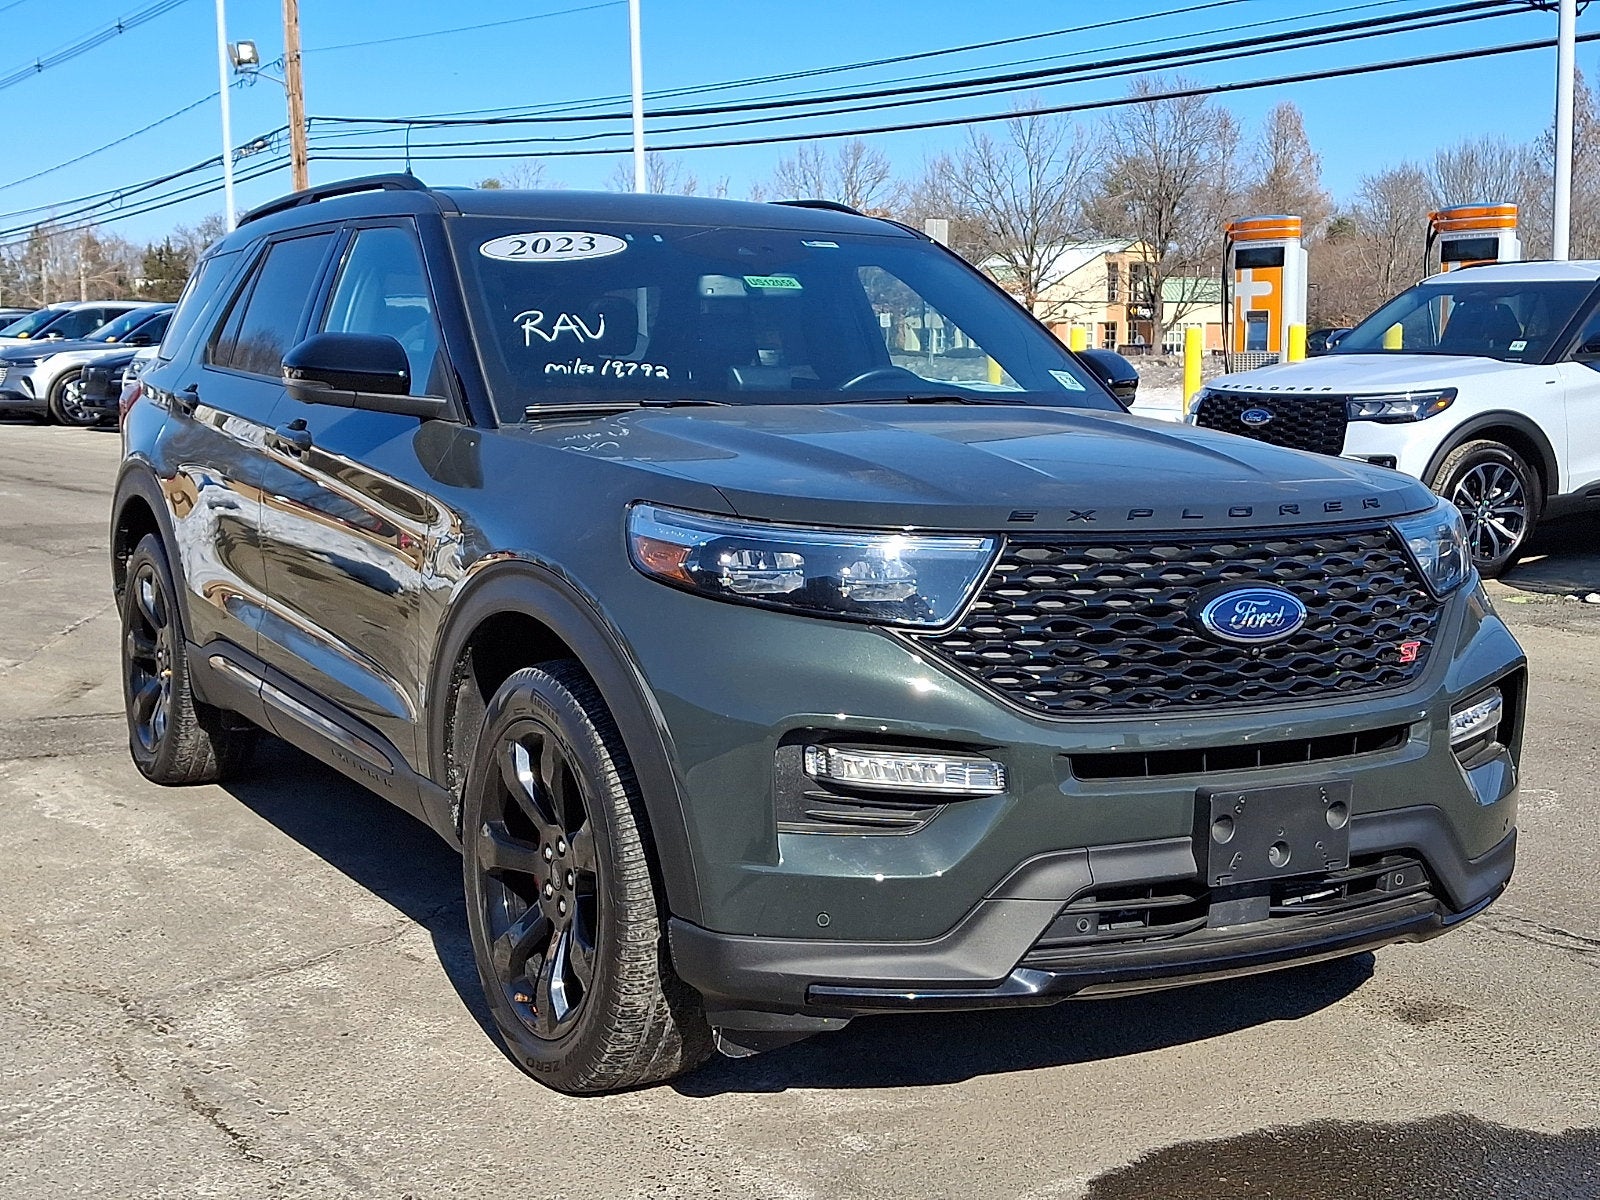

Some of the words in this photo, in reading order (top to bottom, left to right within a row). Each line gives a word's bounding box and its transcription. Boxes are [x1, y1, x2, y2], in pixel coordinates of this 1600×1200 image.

[507, 236, 597, 256] 2023
[544, 357, 595, 375] miles
[1006, 497, 1382, 523] EXPLORER
[1229, 600, 1285, 629] Ford
[1400, 641, 1421, 662] ST
